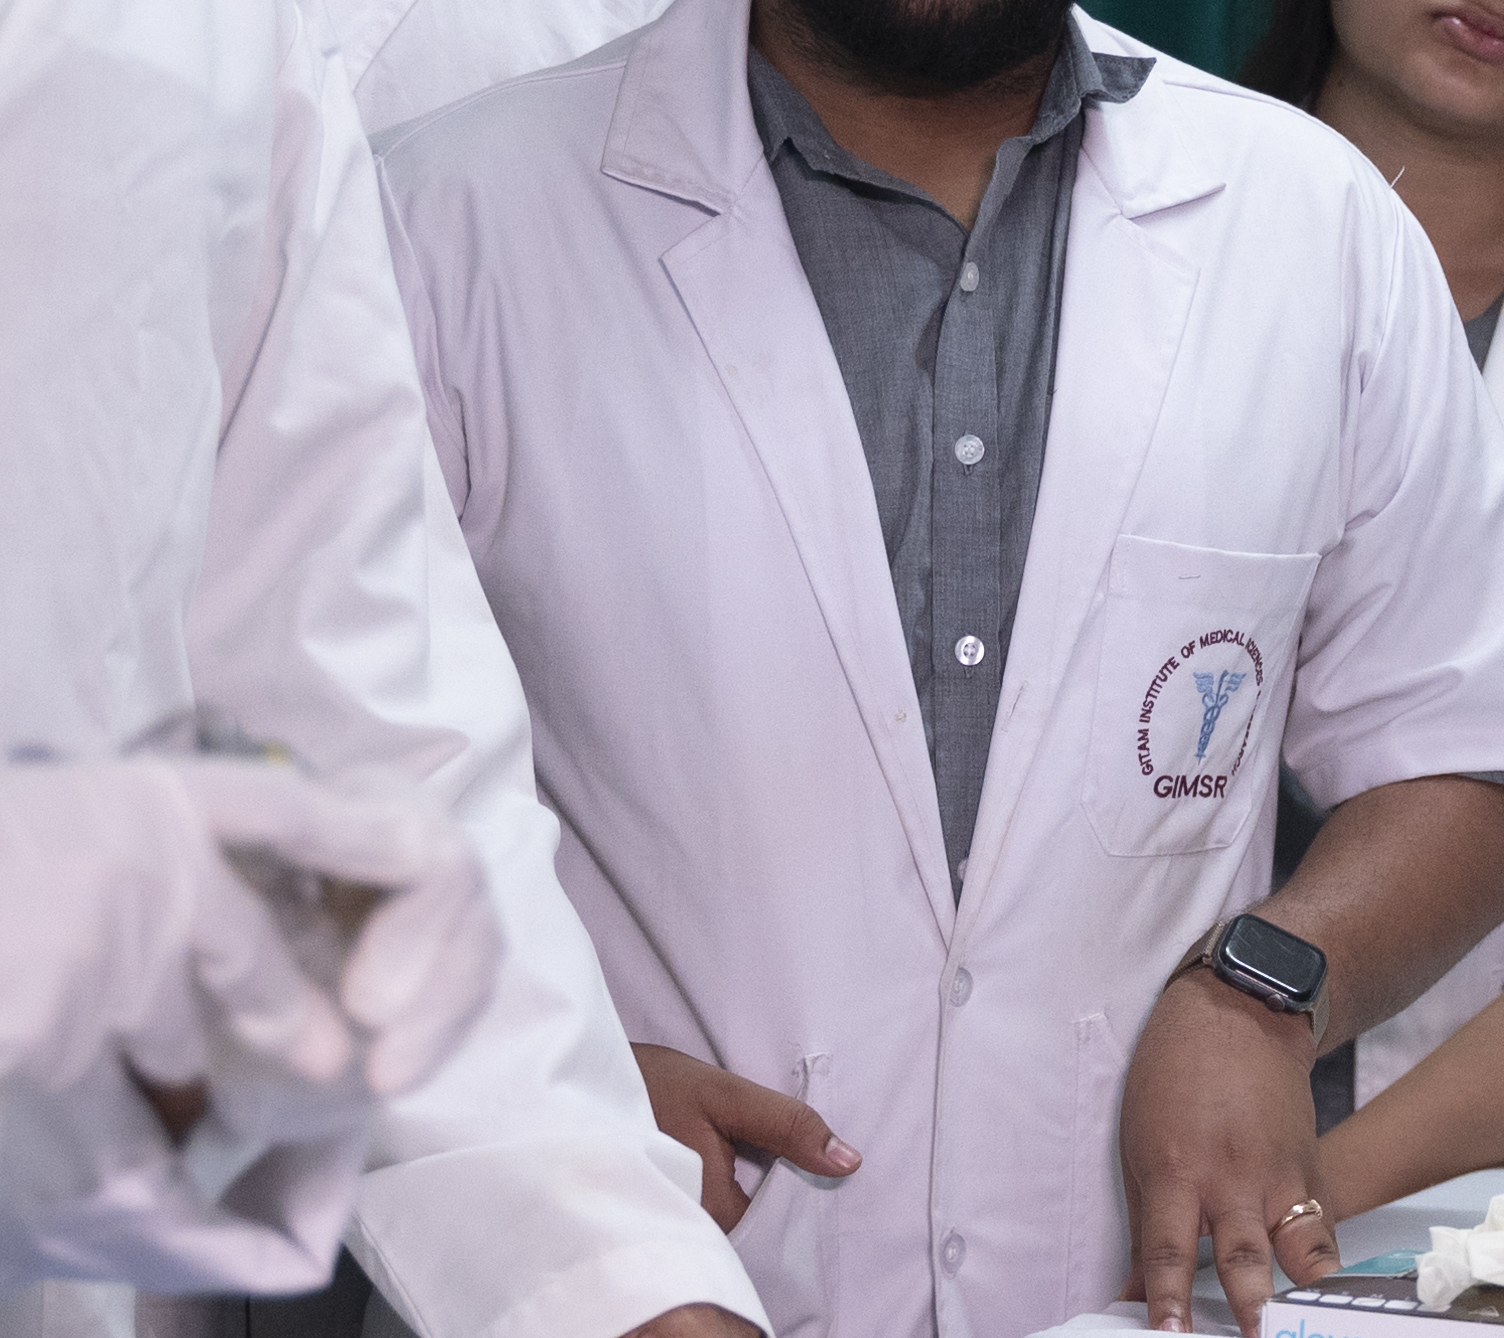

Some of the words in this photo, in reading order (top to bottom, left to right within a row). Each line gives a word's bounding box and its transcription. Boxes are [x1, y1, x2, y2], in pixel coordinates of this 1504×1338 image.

[1180, 640, 1196, 659] OF
[1199, 629, 1245, 649] MEDICAL
[1139, 656, 1180, 724] INSTITUTE
[1137, 728, 1154, 776] GITAM
[1153, 774, 1228, 799] GIMSR
